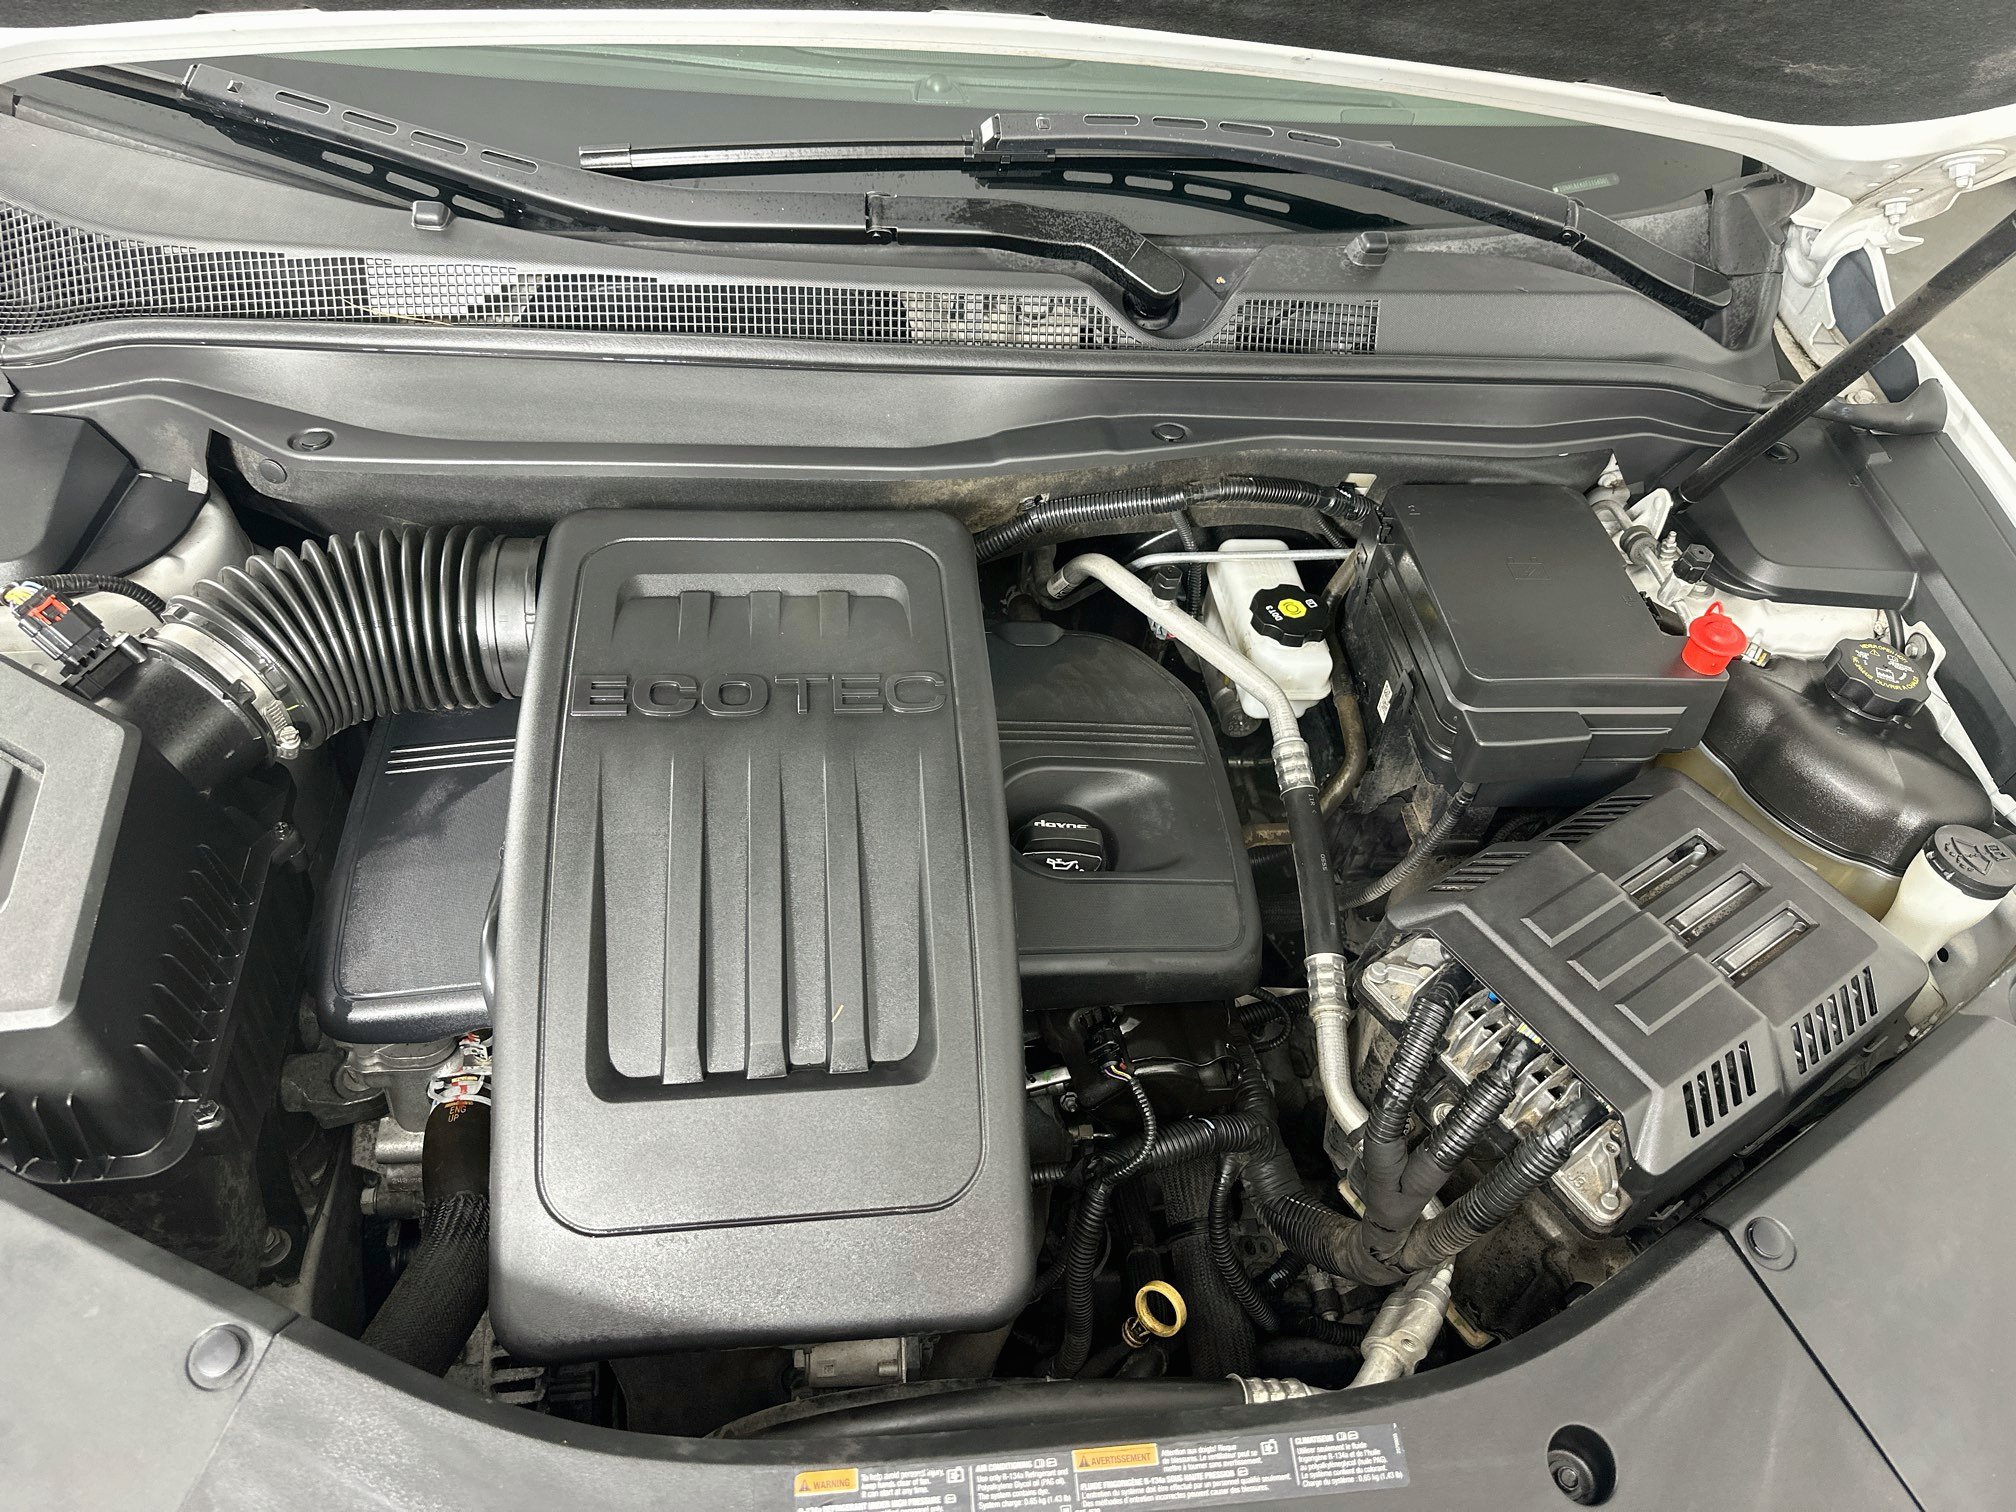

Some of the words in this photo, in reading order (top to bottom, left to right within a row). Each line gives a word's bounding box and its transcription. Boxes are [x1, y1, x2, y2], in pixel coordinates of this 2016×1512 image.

[570, 671, 948, 717] ECOTEC
[450, 1106, 466, 1114] ENG
[448, 1114, 459, 1122] UP
[1092, 1452, 1150, 1465] AVERTISSEMENT
[1328, 1451, 1349, 1460] R-134a
[1002, 1472, 1024, 1480] R-134a
[813, 1478, 850, 1489] WARNING
